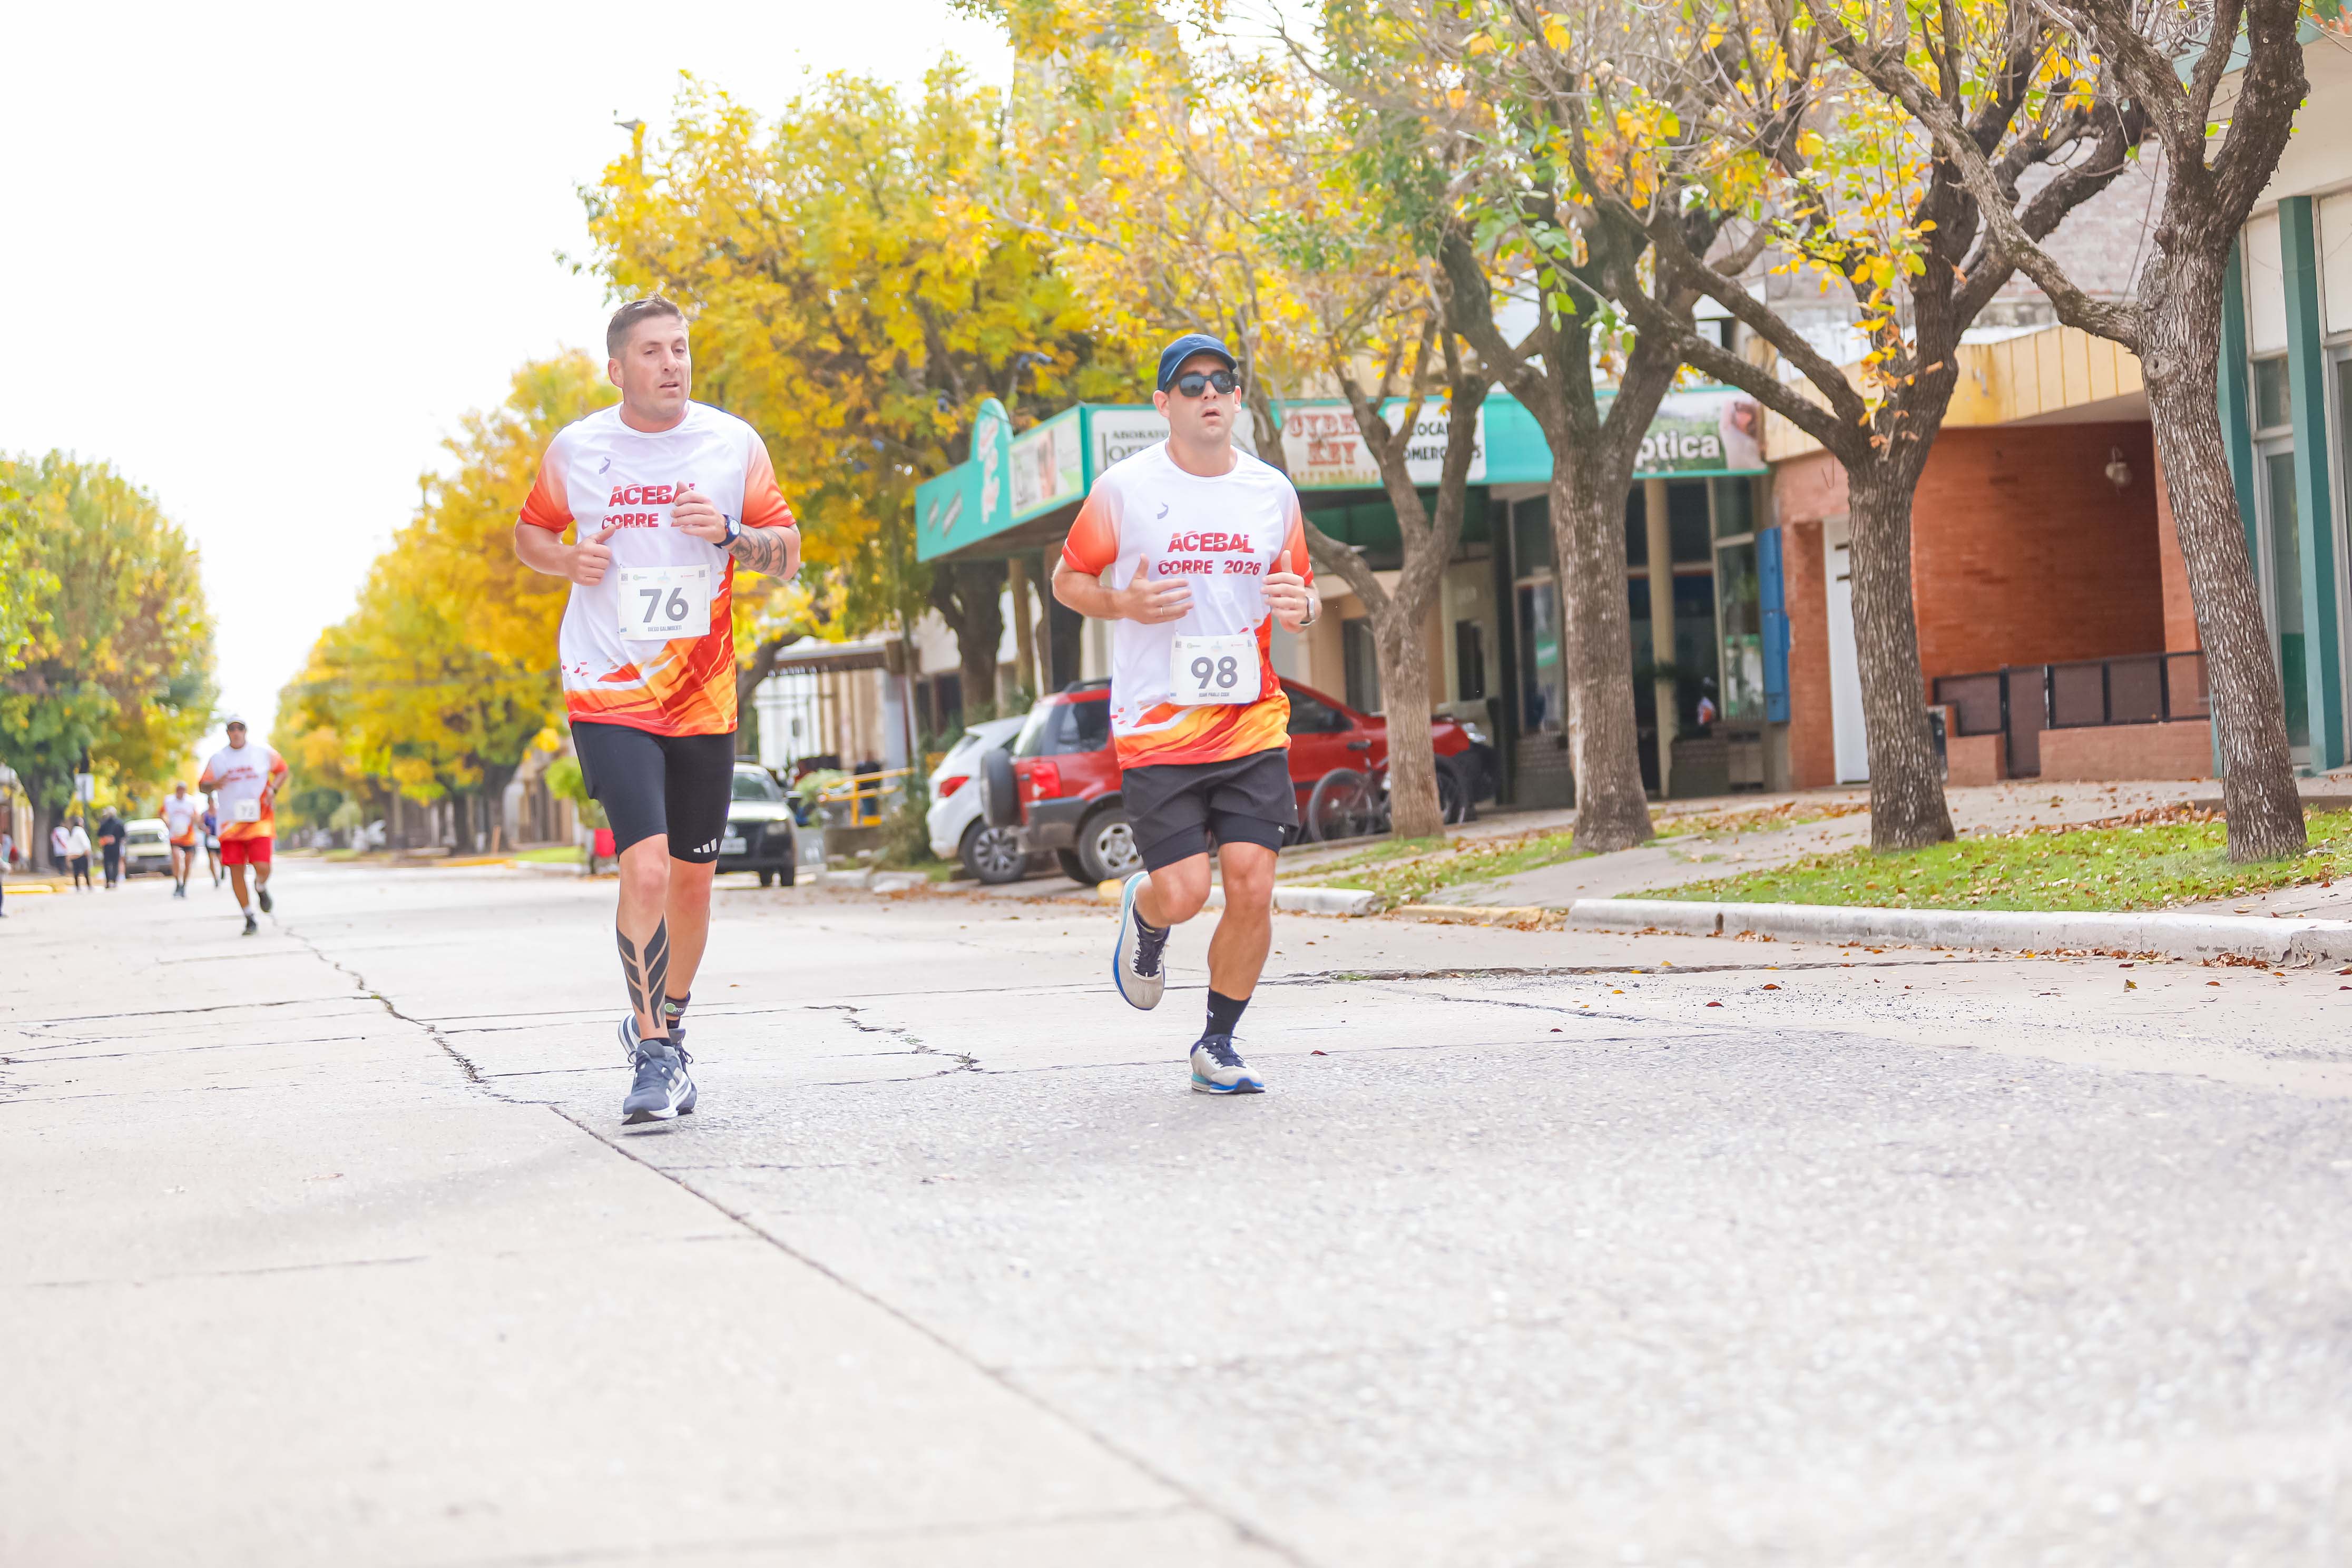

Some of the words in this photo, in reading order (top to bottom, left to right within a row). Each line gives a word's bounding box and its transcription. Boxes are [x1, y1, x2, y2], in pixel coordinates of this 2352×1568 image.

[1634, 430, 1721, 468] ptica
[602, 512, 659, 530] CORRE
[1167, 531, 1255, 554] ACEBAL
[1158, 559, 1214, 575] CORRE
[1222, 559, 1262, 576] 2026
[639, 587, 689, 623] 76
[1191, 656, 1238, 689] 98
